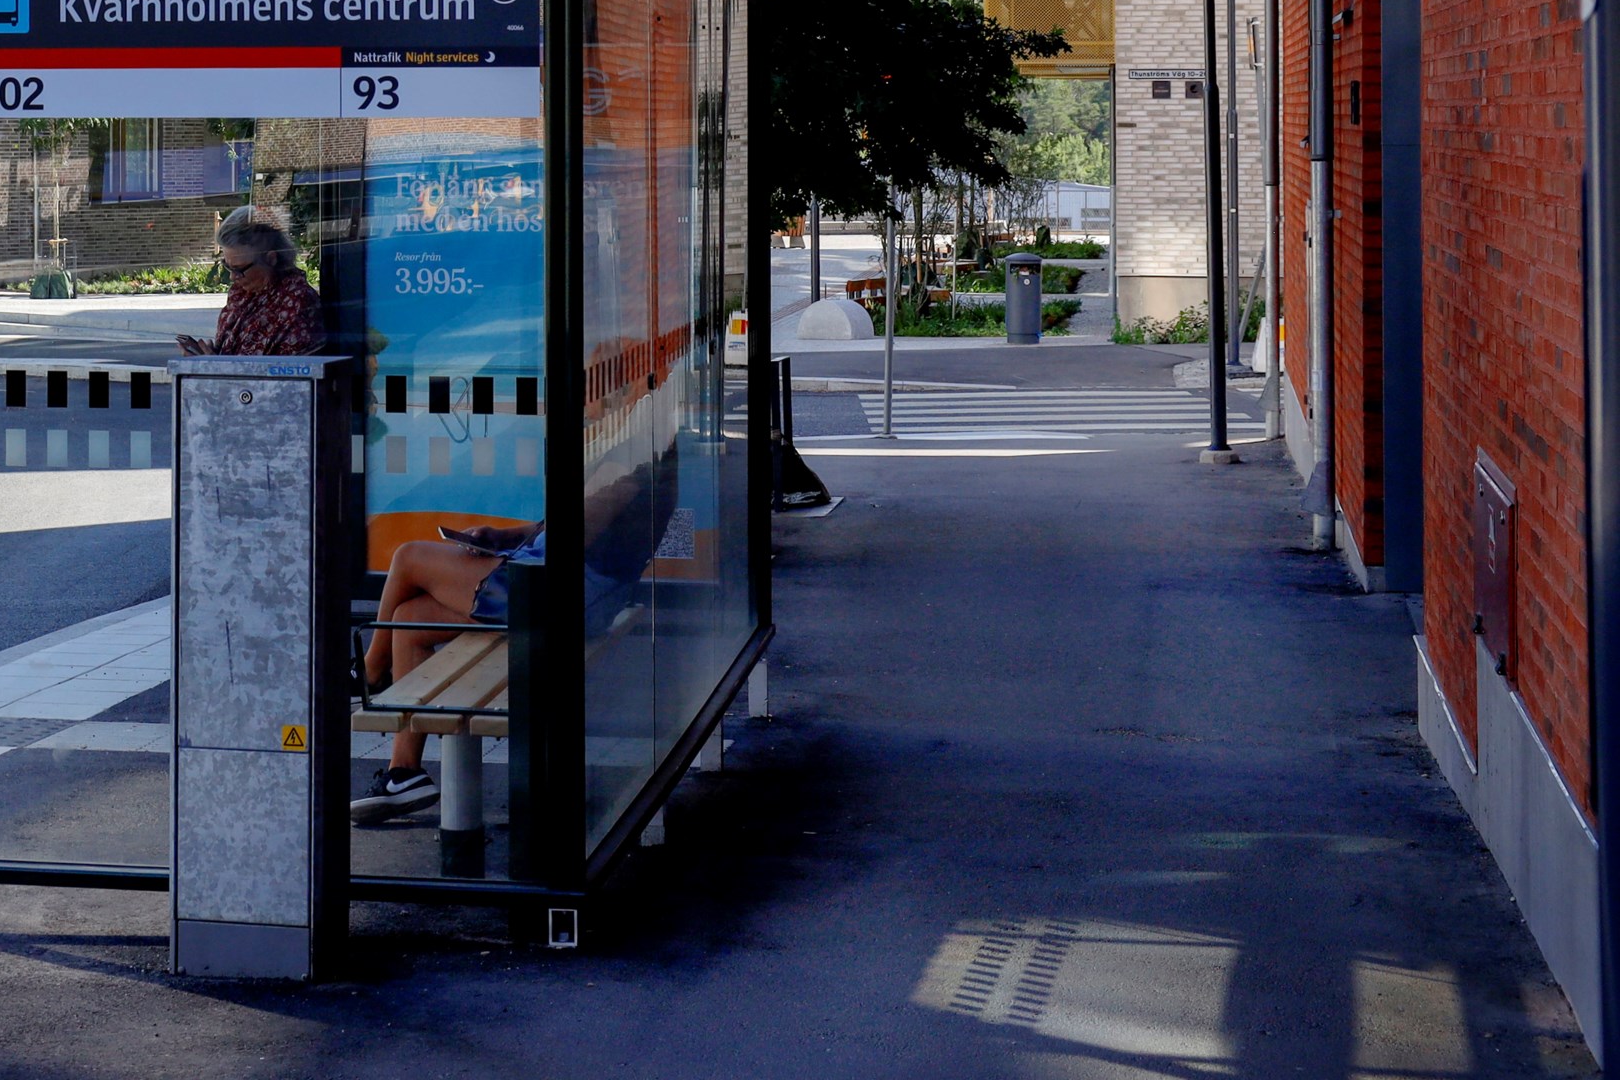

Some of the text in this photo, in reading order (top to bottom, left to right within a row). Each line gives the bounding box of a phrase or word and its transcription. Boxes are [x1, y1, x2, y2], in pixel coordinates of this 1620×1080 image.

[354, 51, 480, 64] Nattrafik Night services
[1171, 71, 1186, 79] Väg
[353, 75, 400, 110] 93
[395, 206, 454, 233] med
[457, 212, 490, 233] en
[394, 251, 442, 263] Resor från
[269, 366, 311, 375] ENSTO
